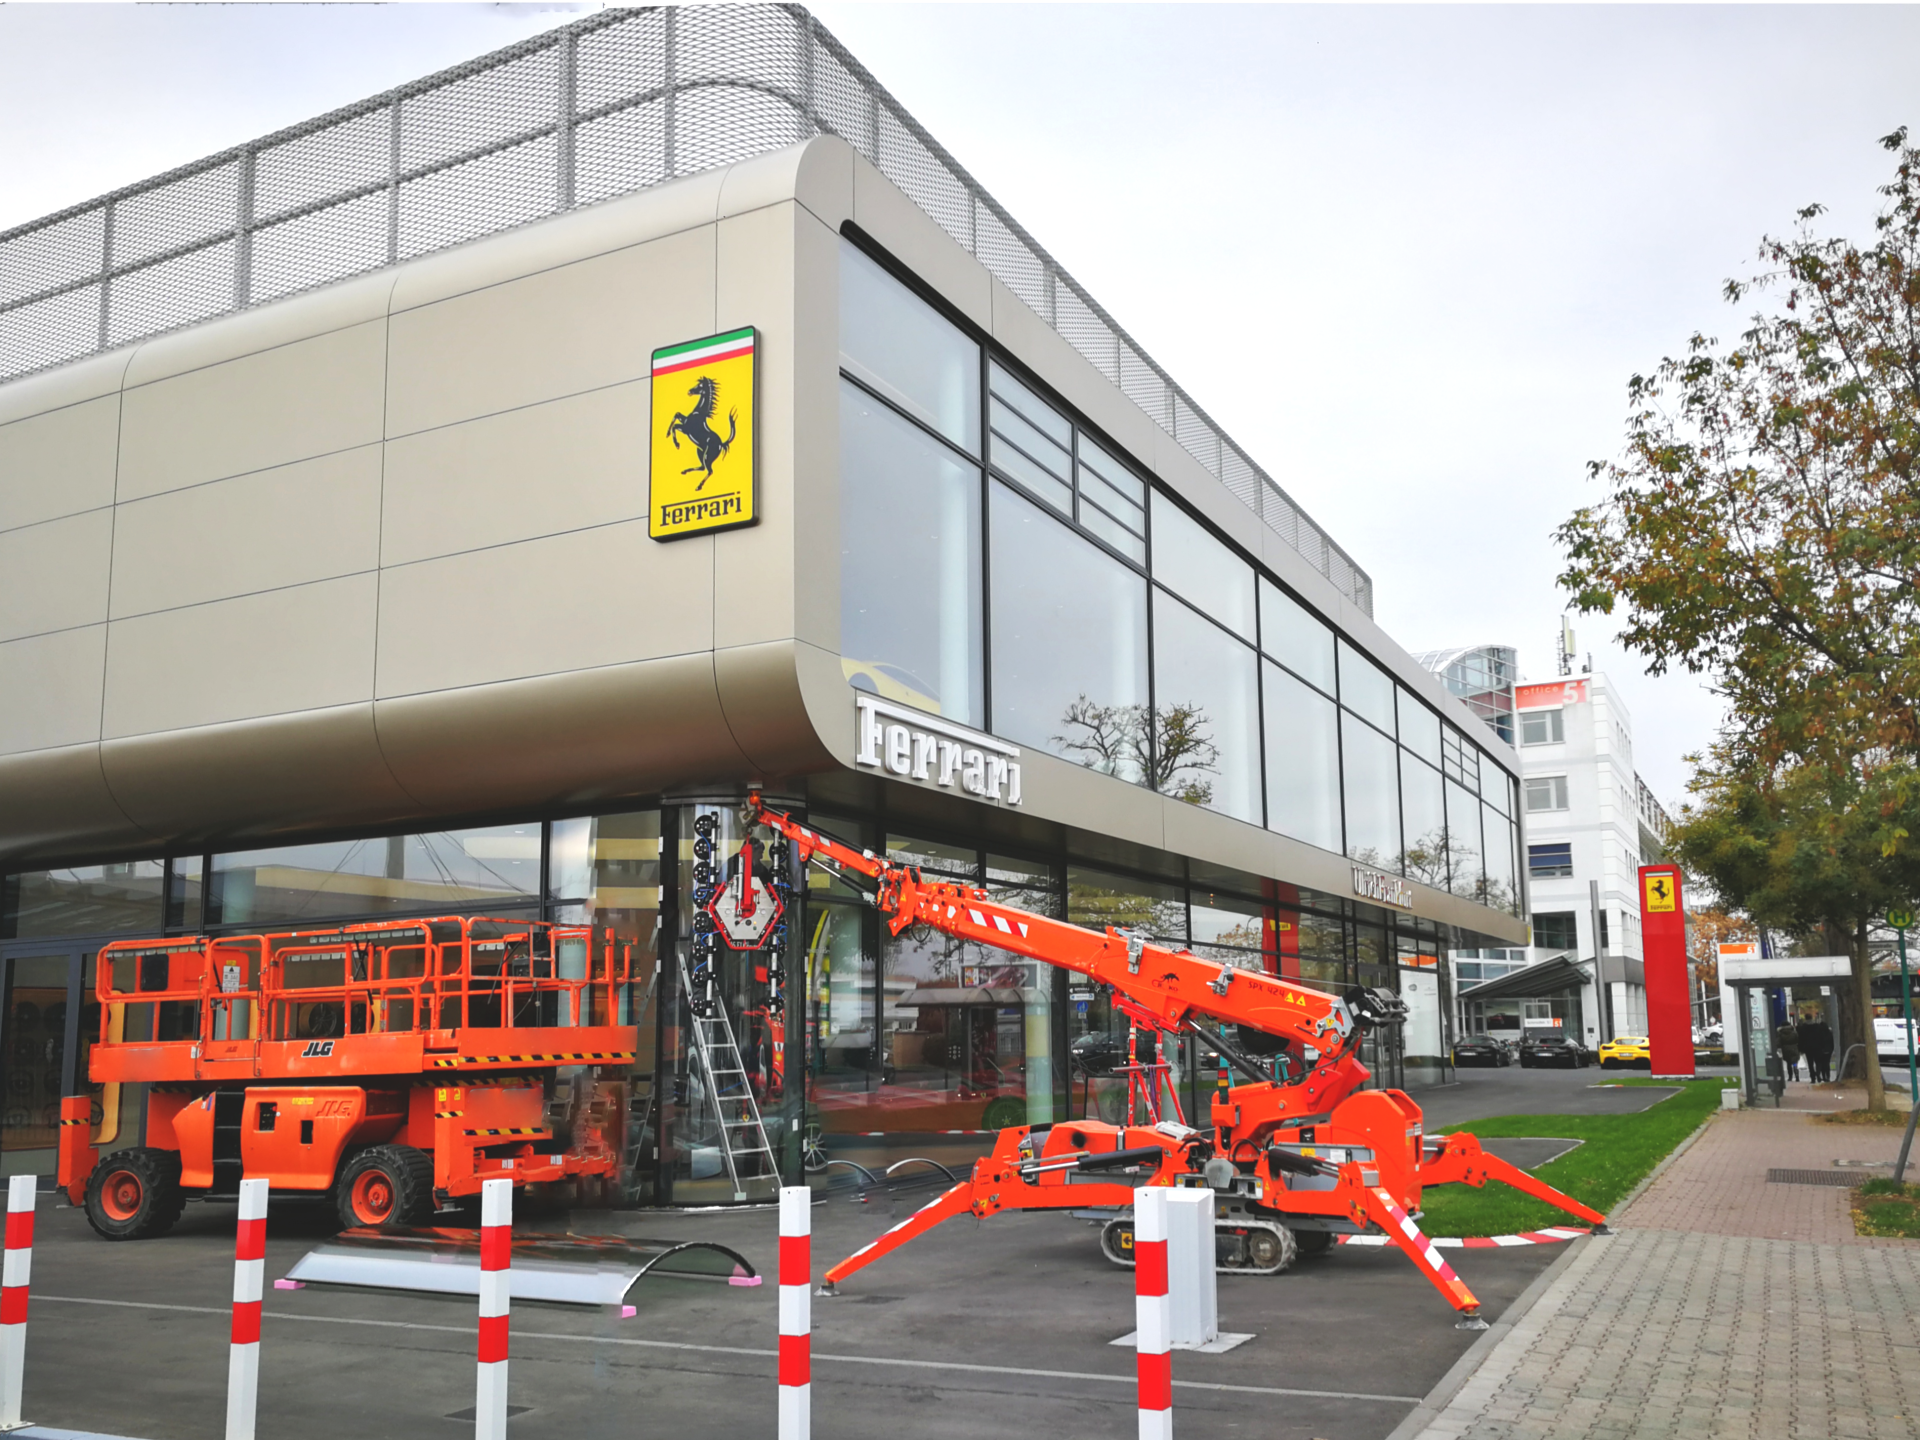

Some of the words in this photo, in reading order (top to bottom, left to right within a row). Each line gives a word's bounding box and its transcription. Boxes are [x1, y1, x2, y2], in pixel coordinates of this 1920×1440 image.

[660, 491, 742, 527] Ferrari
[1523, 686, 1559, 696] office
[1562, 681, 1591, 705] 51
[857, 697, 1022, 806] Ferrari
[1247, 980, 1263, 992] SPX
[1267, 986, 1285, 998] 424
[302, 1041, 335, 1057] JLG
